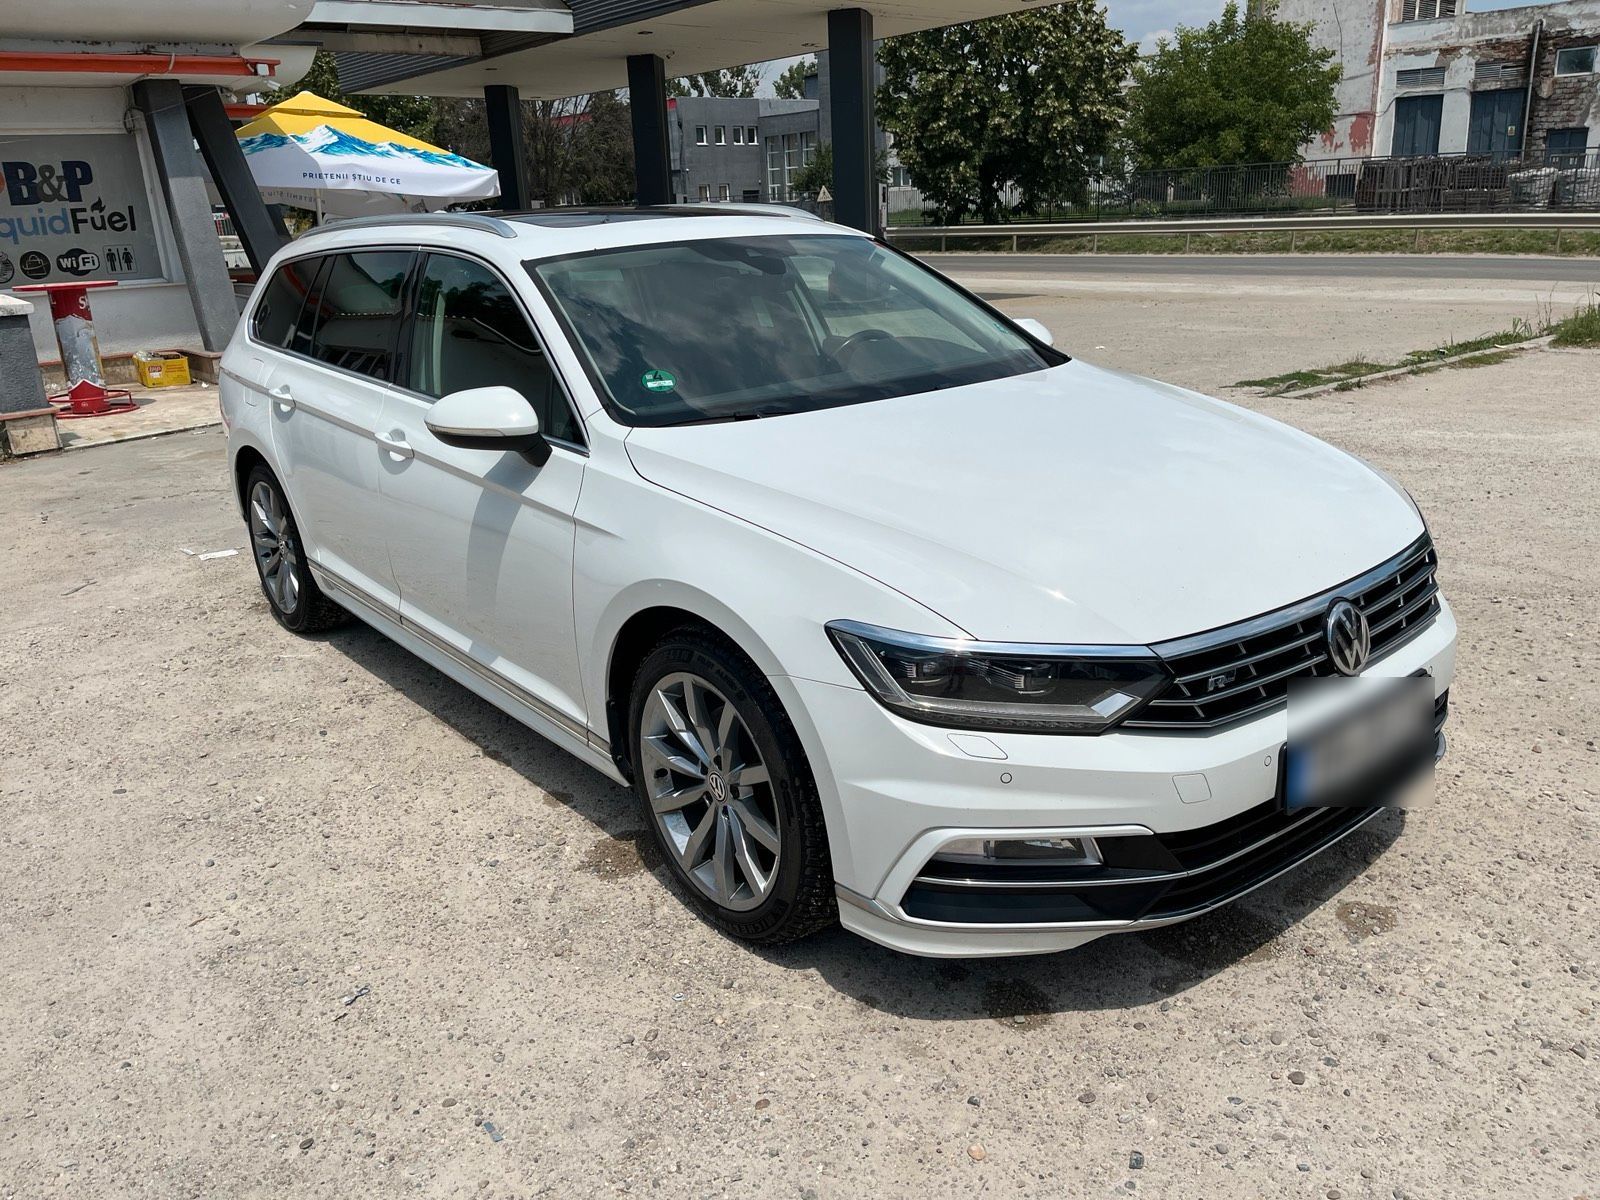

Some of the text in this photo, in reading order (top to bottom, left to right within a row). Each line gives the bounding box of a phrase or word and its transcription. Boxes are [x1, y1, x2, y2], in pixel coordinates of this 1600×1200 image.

[302, 172, 348, 180] PRIETENII
[2, 161, 93, 206] B&P
[653, 370, 663, 380] 4
